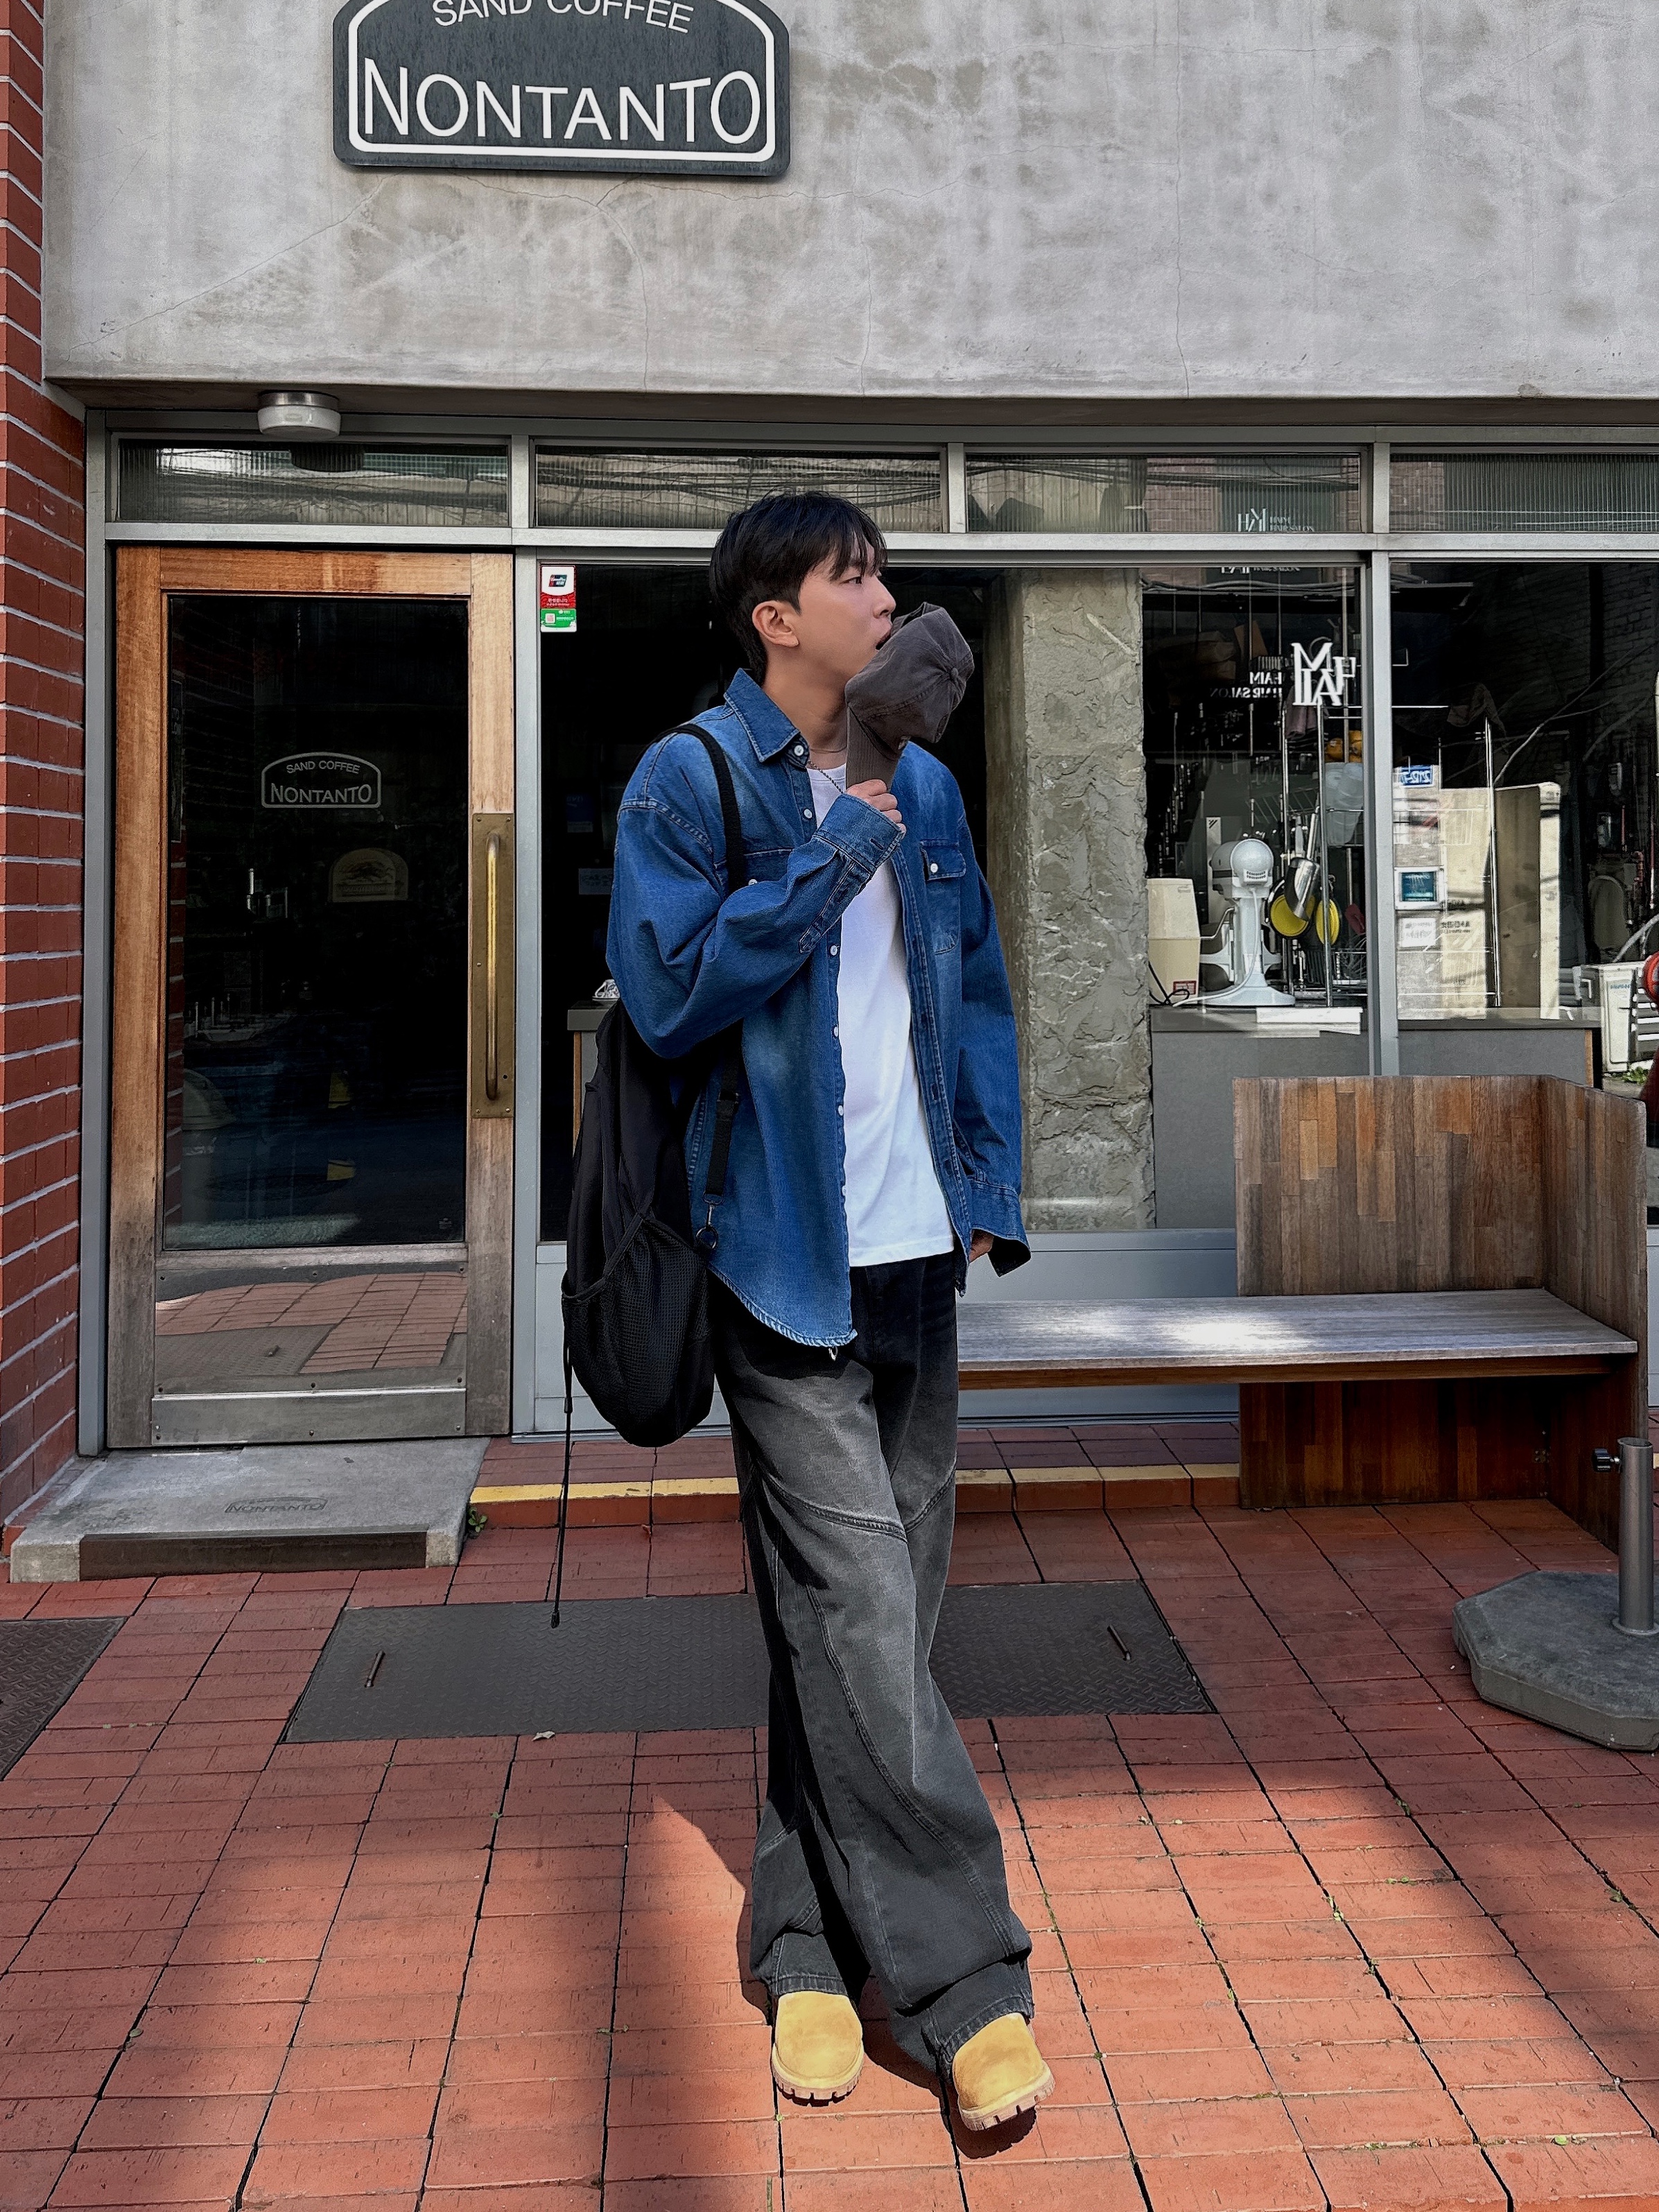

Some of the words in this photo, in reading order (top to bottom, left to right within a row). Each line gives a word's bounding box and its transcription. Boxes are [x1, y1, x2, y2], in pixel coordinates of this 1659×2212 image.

[363, 58, 761, 144] NONTANTO
[286, 761, 315, 774] SAND
[318, 761, 361, 775] COFFEE
[271, 784, 372, 803] NONTANTO
